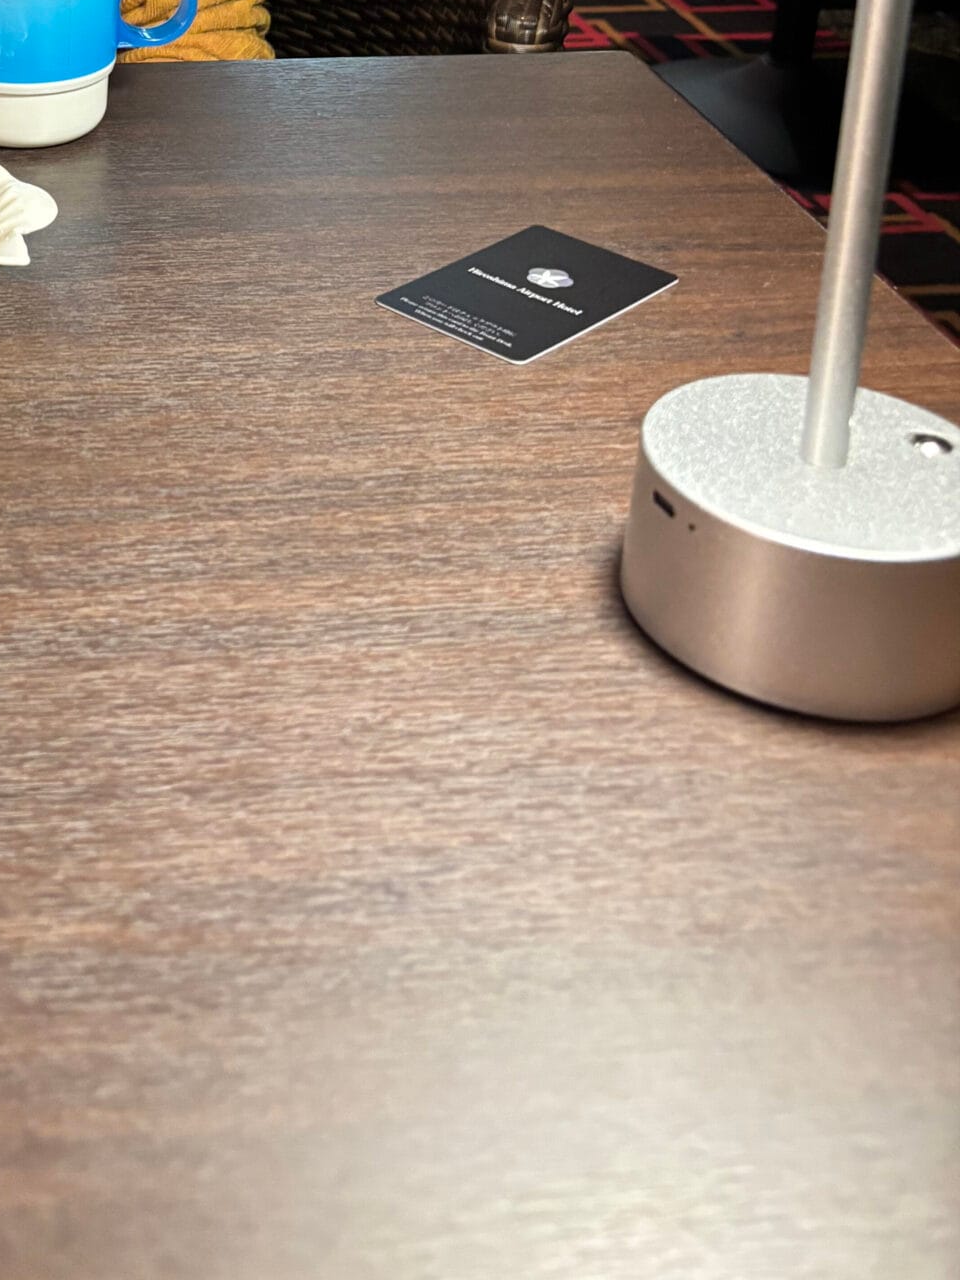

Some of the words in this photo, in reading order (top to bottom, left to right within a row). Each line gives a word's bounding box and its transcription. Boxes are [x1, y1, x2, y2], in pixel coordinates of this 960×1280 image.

[468, 266, 517, 290] Hiroshima
[516, 287, 554, 305] Airport
[552, 300, 584, 316] Hotel
